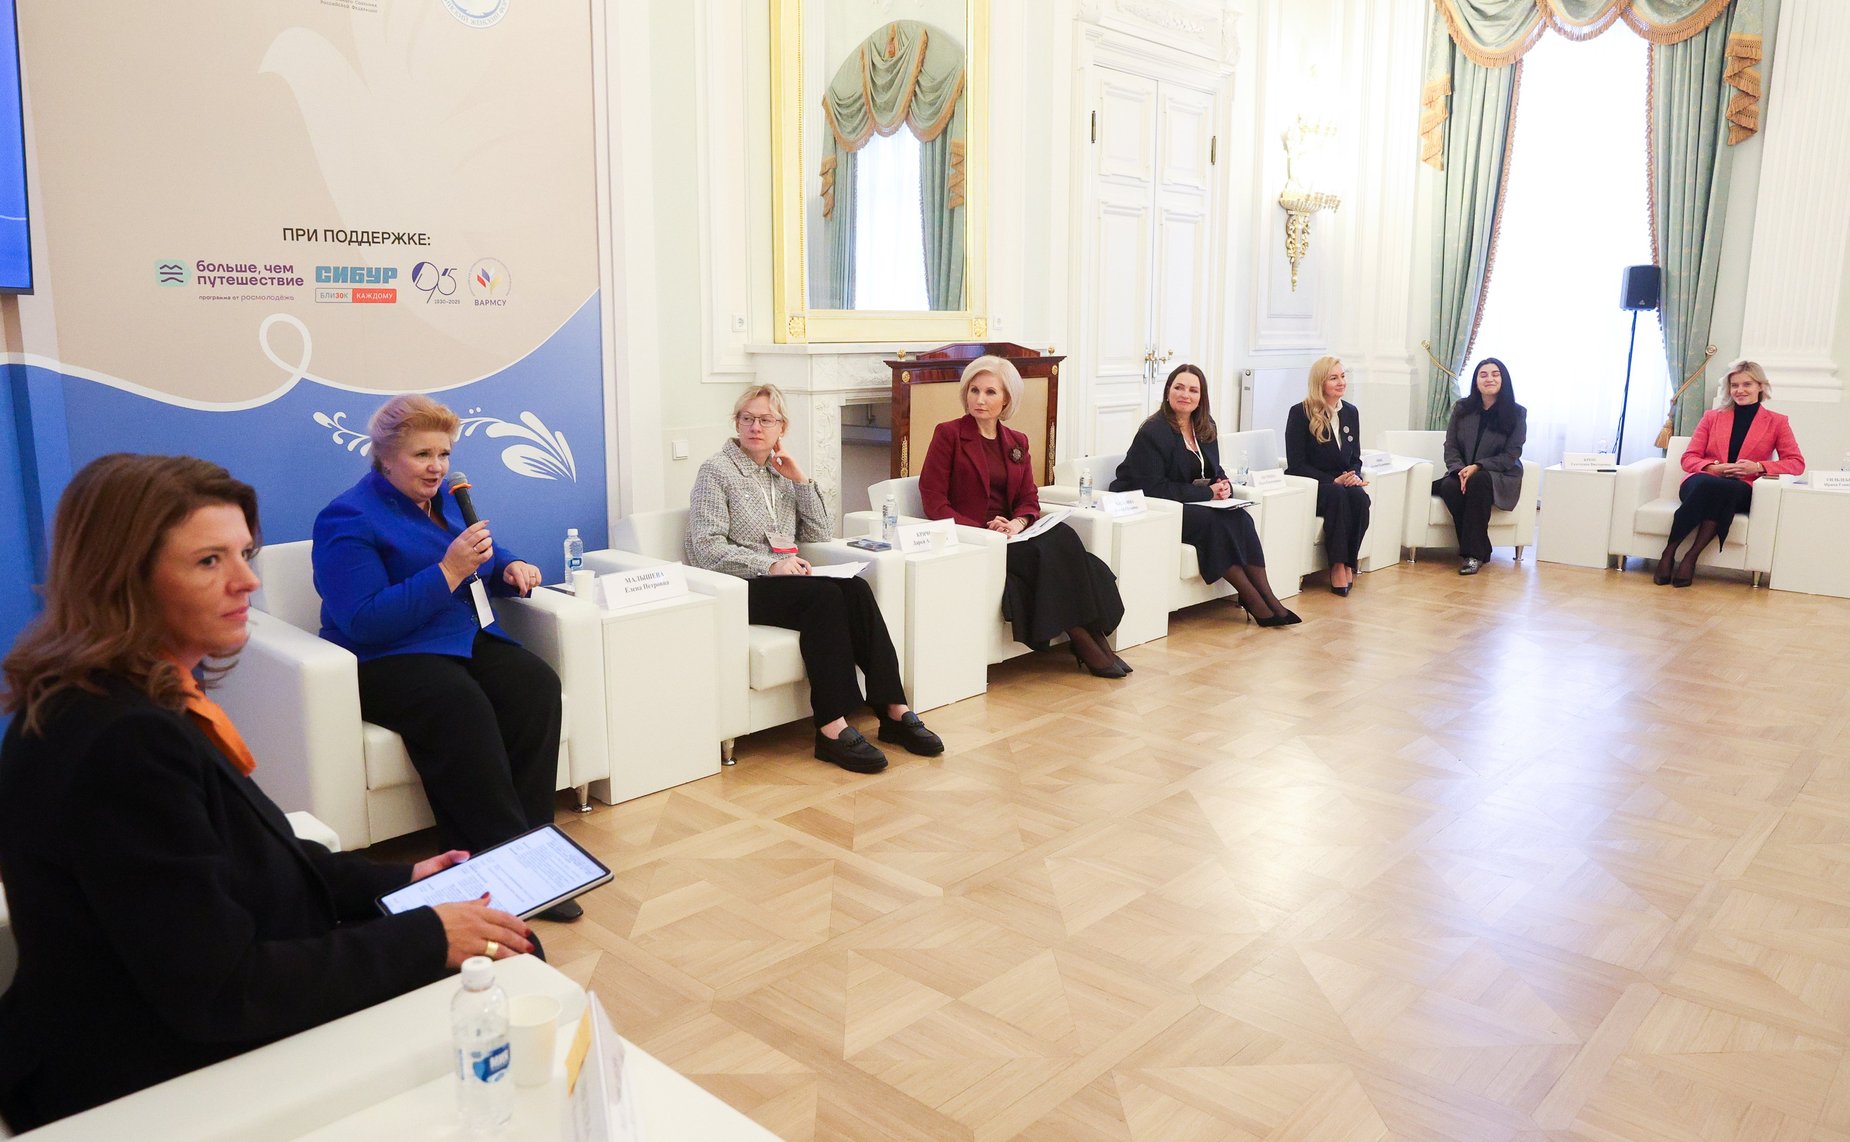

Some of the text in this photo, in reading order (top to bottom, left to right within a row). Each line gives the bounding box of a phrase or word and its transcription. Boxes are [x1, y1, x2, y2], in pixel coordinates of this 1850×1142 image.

[283, 228, 431, 246] ПРИ ПОДДЕРЖКЕ:
[196, 260, 294, 275] больше, чем
[315, 266, 398, 284] СИБУР
[197, 275, 304, 288] путешествие
